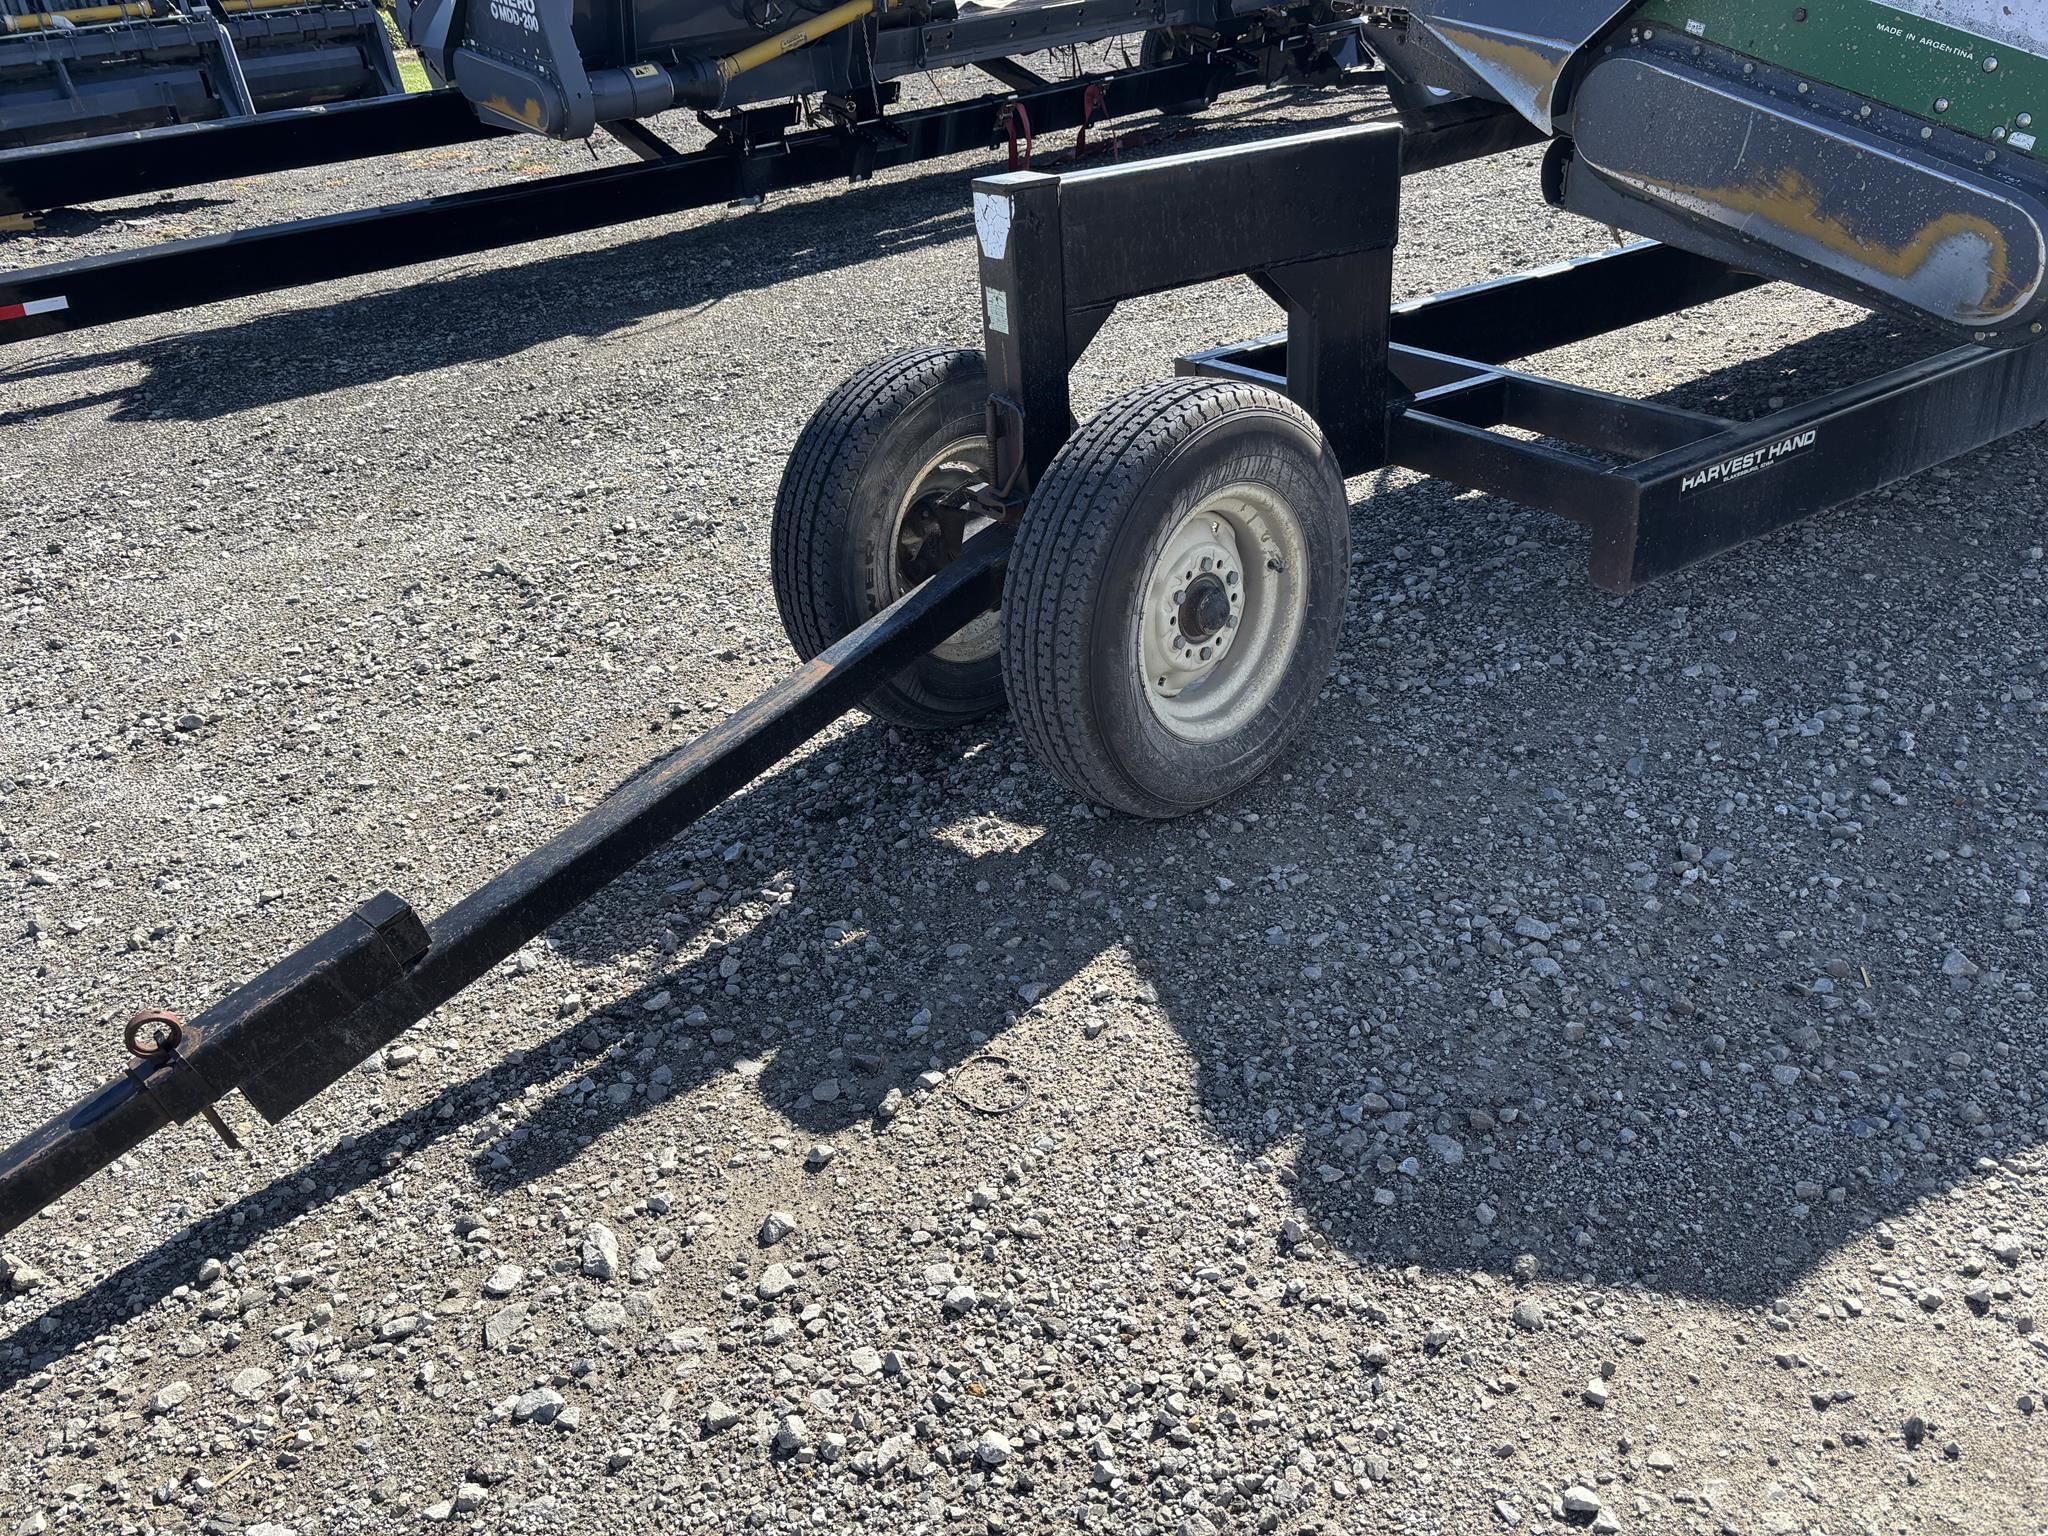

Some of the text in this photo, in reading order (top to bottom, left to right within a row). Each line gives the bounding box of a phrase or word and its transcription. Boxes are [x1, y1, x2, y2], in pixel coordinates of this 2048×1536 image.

[1876, 23, 1974, 60] MADE IN ARGENTINA
[1681, 430, 1816, 492] HARVEST HAND
